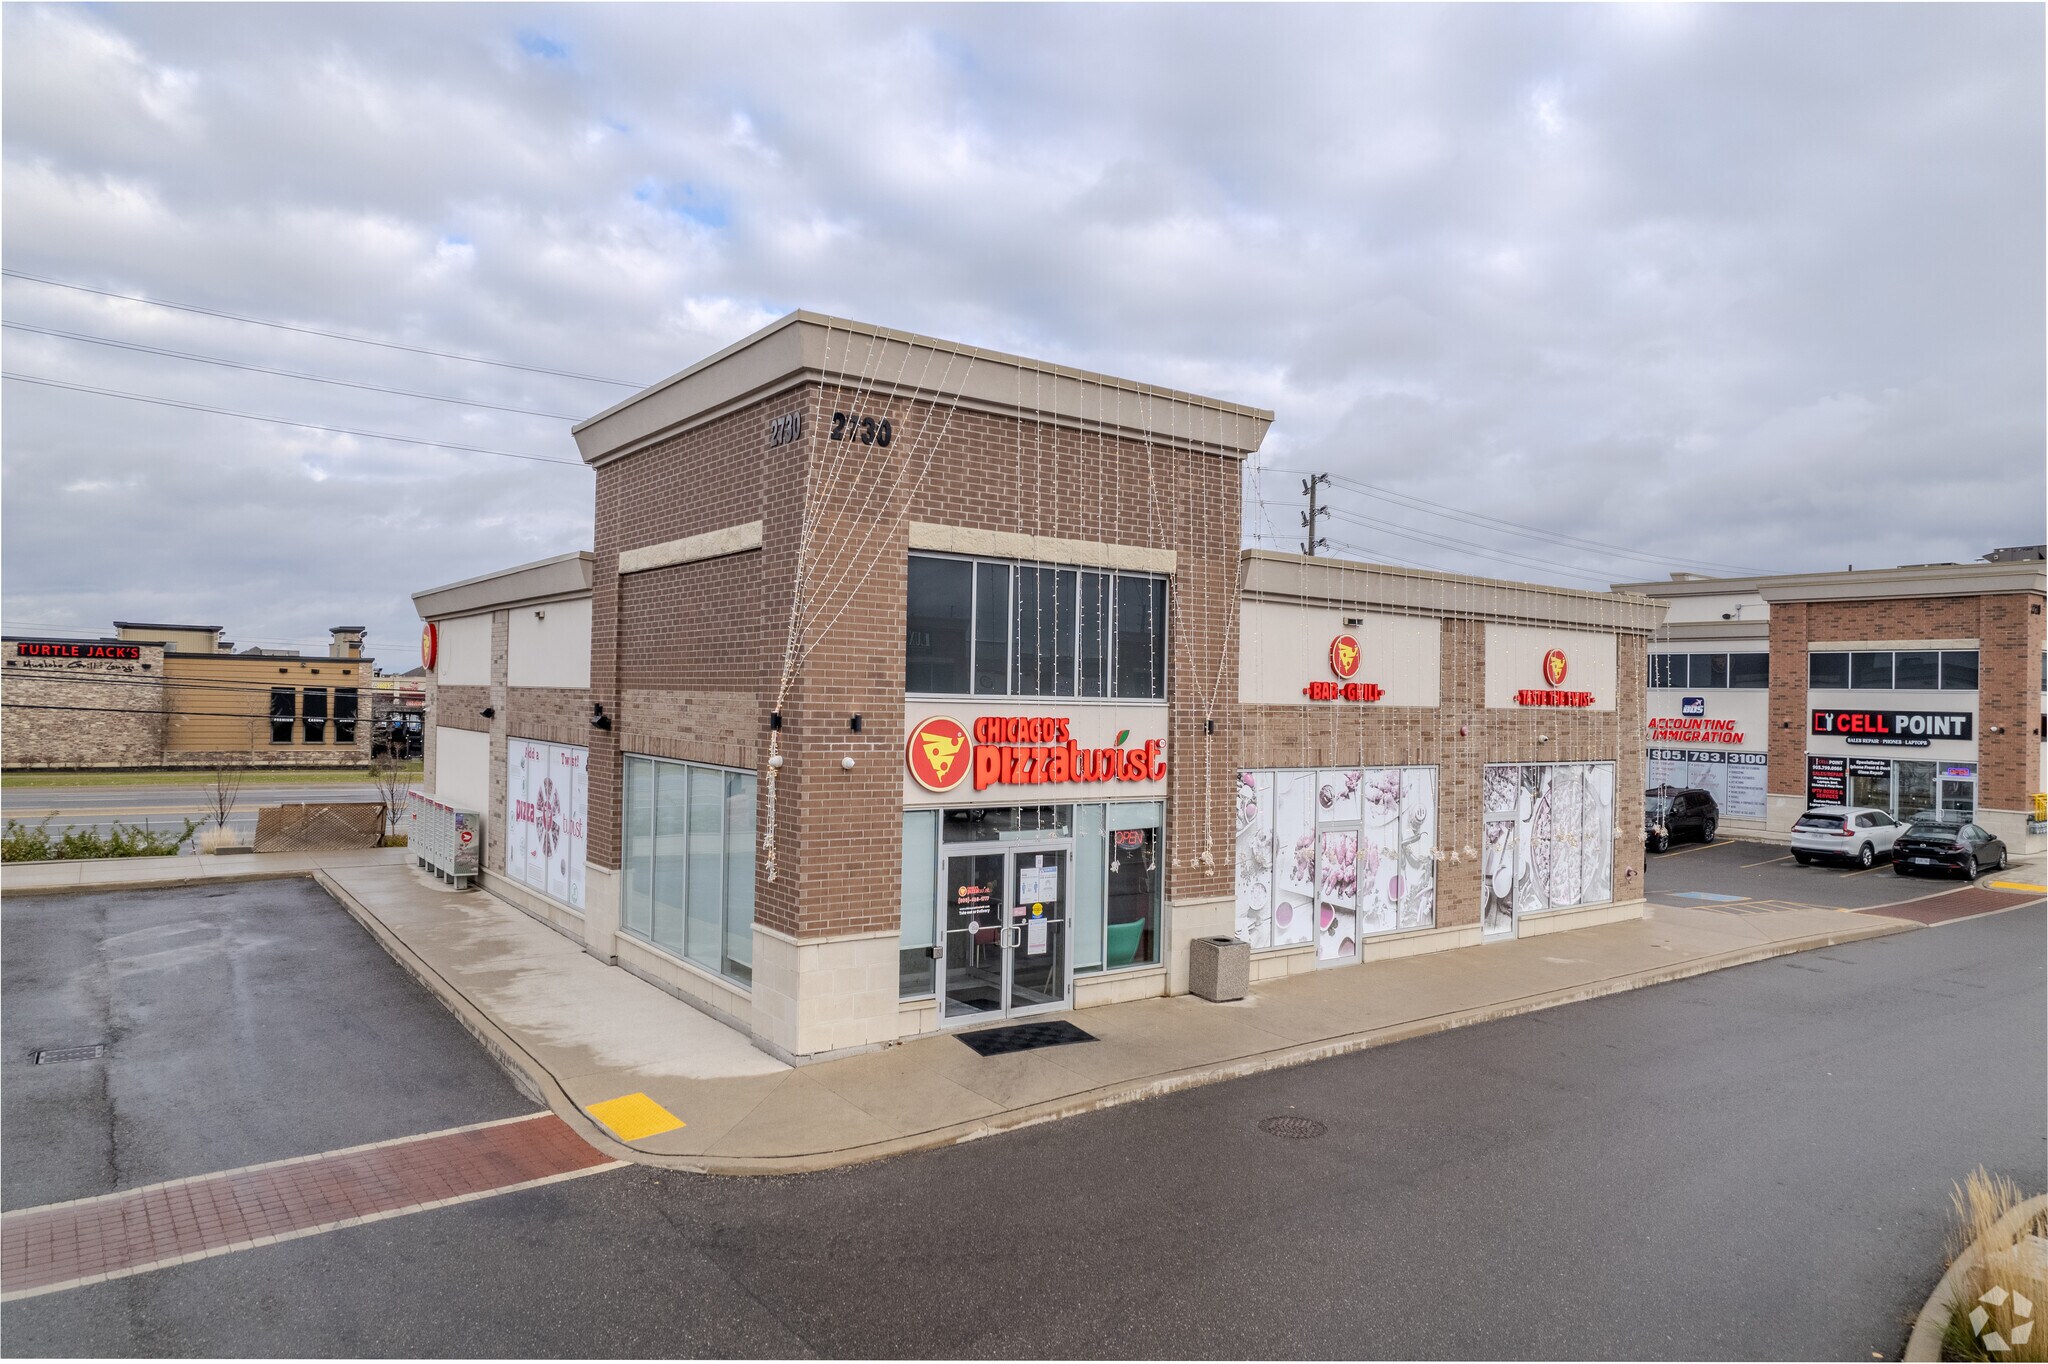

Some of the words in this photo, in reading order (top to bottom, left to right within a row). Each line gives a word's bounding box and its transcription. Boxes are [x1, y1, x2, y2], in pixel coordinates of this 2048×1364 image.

[770, 411, 801, 448] 2730
[831, 412, 891, 447] 2730
[19, 644, 79, 656] TURTLE
[87, 647, 139, 658] JACK'S
[1310, 682, 1339, 701] BAR
[974, 717, 1070, 744] CHICAGO'S
[1648, 718, 1736, 731] ACCOUNTING
[1837, 713, 1889, 733] CELL
[1895, 715, 1966, 736] POINT
[1652, 730, 1745, 744] IMMIGRATION
[1729, 753, 1766, 765] 3100
[516, 799, 535, 823] pizza
[1114, 831, 1143, 845] OPEN
